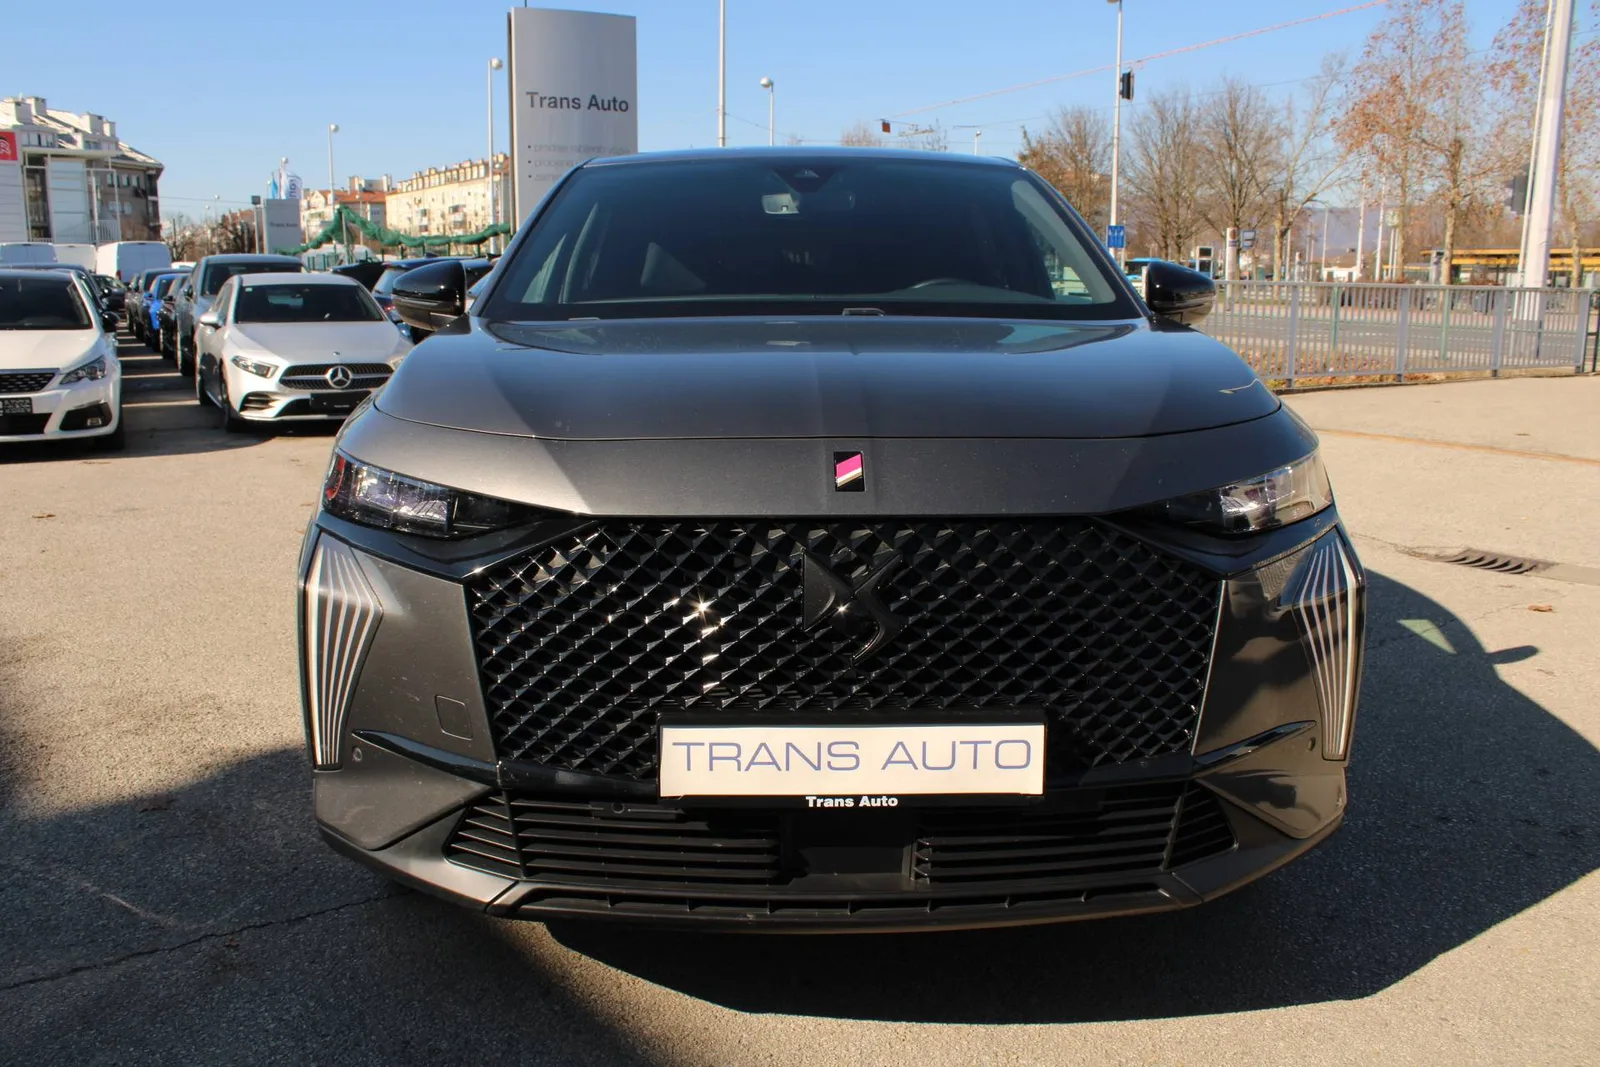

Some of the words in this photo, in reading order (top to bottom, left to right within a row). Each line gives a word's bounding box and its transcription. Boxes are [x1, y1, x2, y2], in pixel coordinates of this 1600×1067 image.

[526, 91, 582, 110] Trans
[587, 94, 629, 112] Auto
[672, 741, 860, 772] TRANS
[881, 739, 1031, 770] AUTO
[806, 796, 854, 808] Trans
[859, 796, 898, 807] Auto
